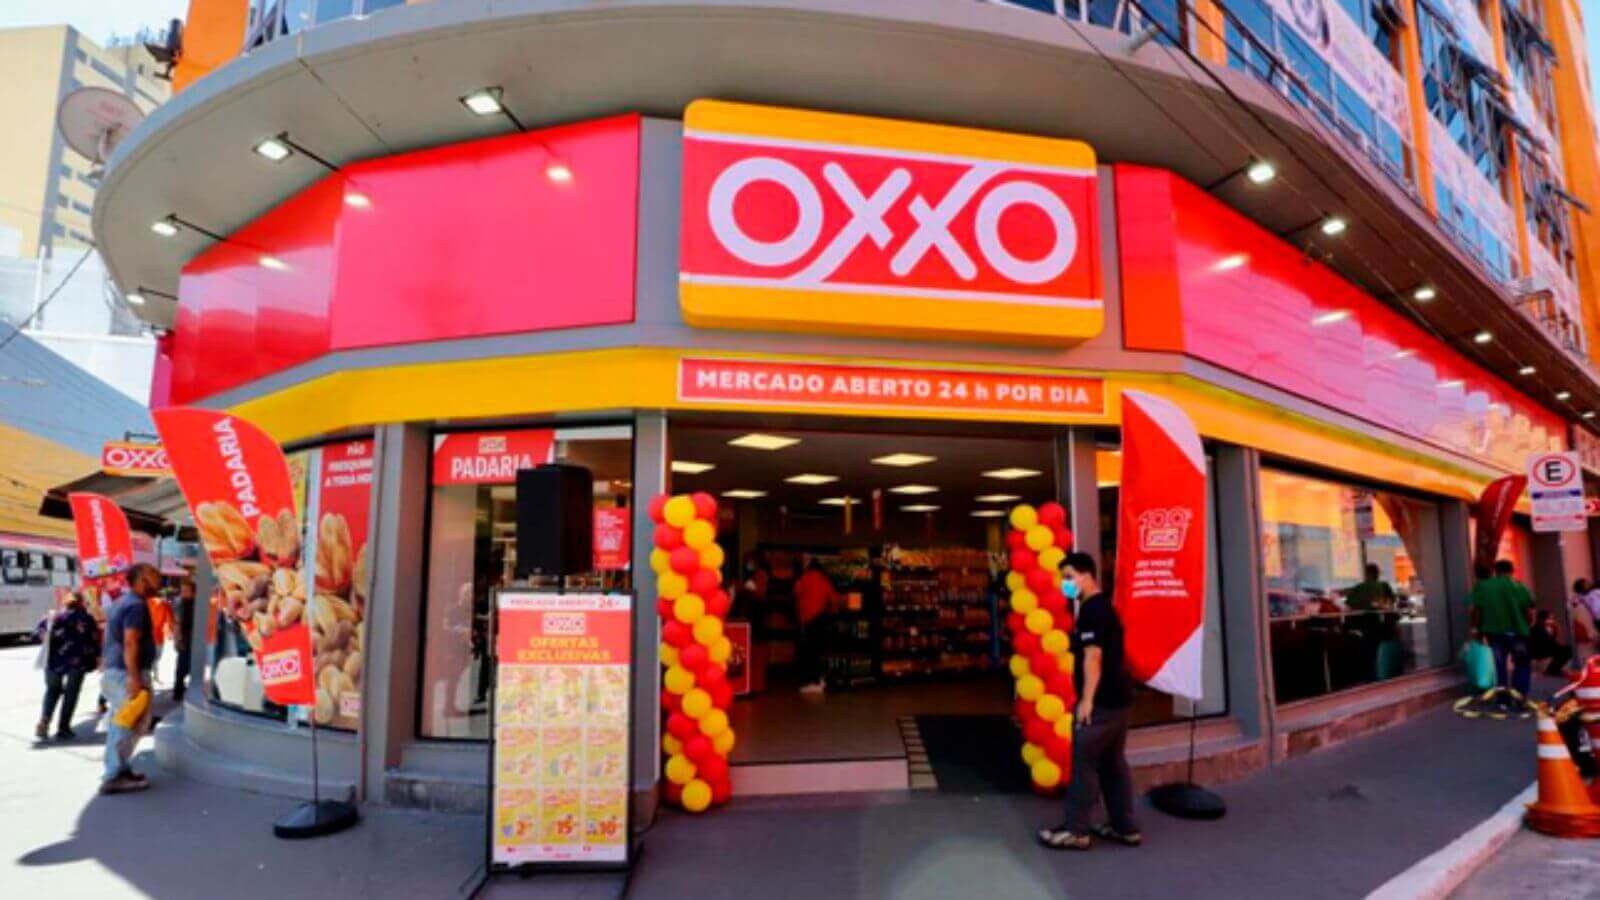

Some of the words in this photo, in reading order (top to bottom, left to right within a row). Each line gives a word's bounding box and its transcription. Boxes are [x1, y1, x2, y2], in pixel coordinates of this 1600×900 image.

[707, 156, 1078, 285] OXXO
[695, 369, 825, 394] MERCADO
[831, 376, 932, 399] ABERTO
[938, 380, 969, 400] 24
[974, 382, 989, 400] h
[994, 383, 1043, 403] POR
[1050, 386, 1090, 405] DIA
[212, 416, 261, 518] PADARIA
[1545, 461, 1563, 481] E
